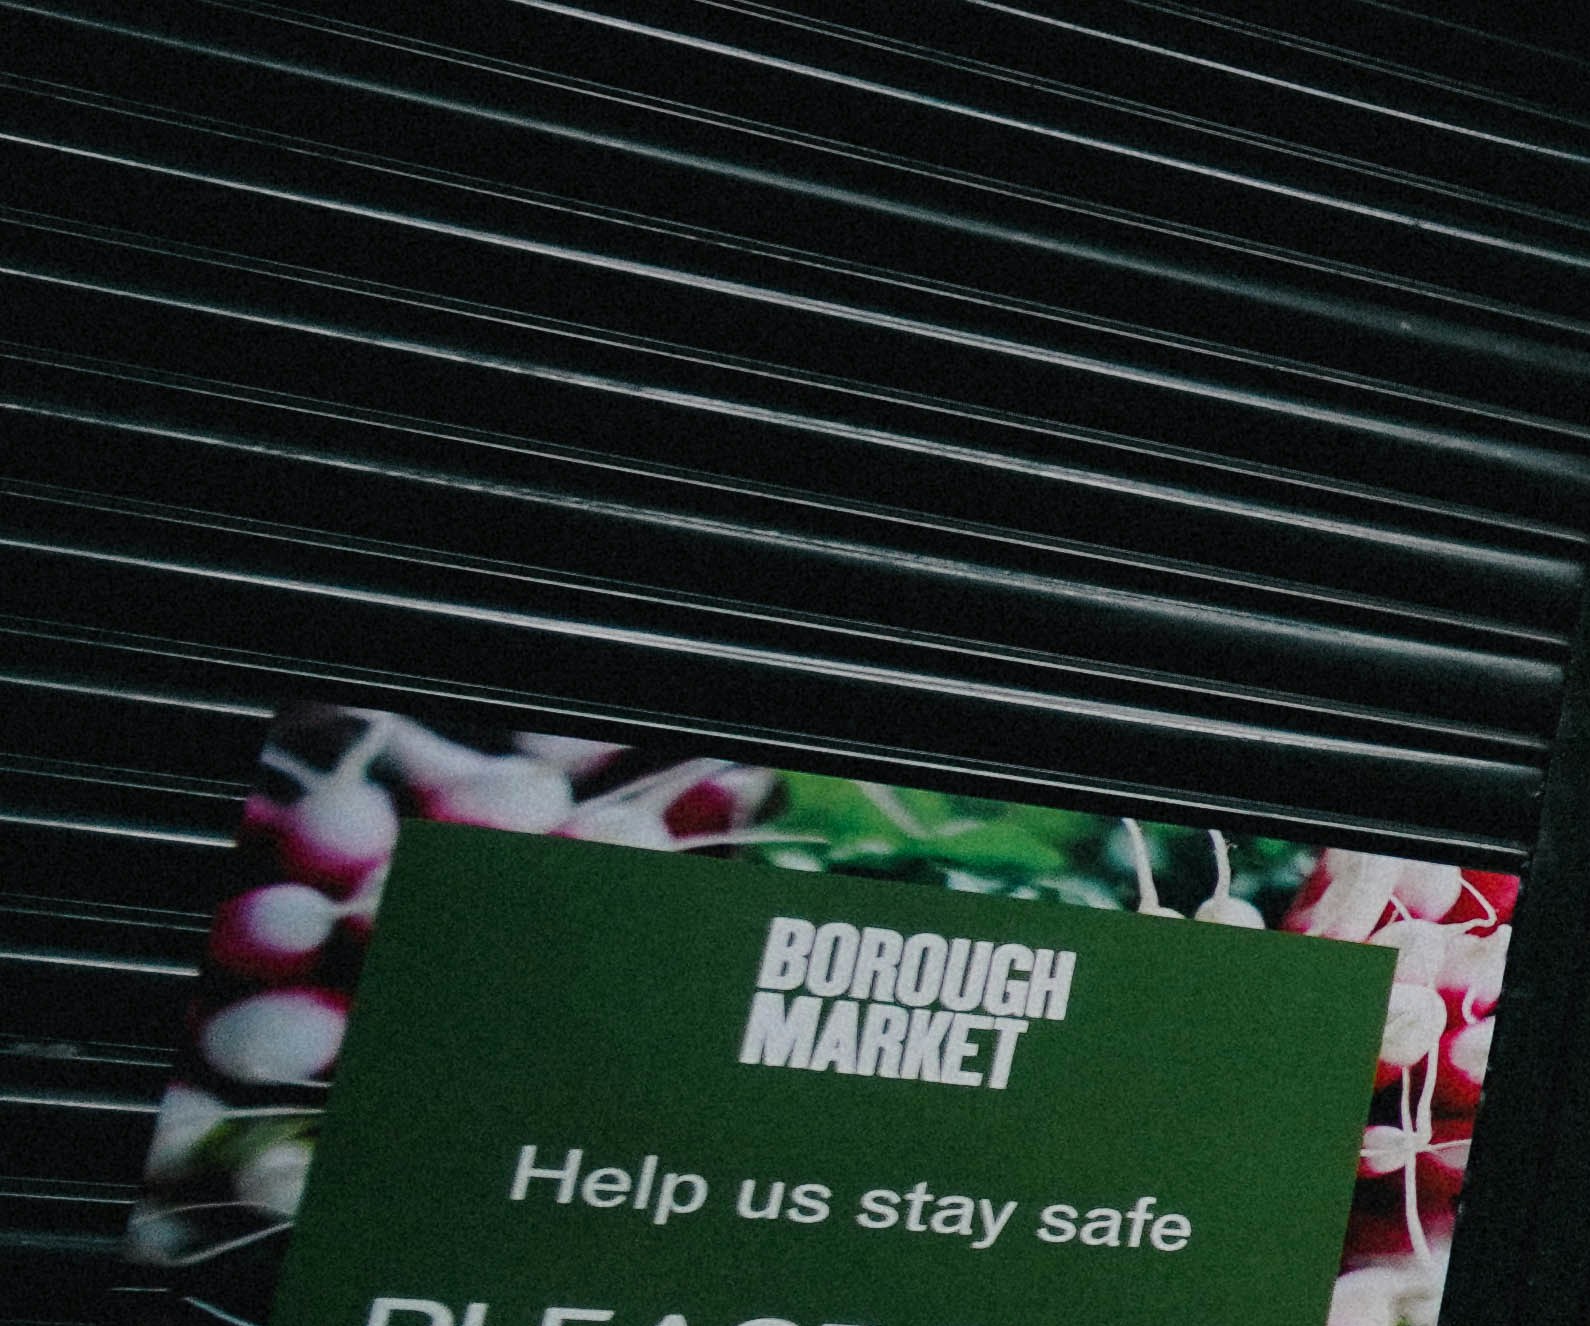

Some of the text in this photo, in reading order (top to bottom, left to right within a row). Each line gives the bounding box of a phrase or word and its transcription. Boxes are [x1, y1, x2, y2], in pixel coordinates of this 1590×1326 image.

[757, 917, 1076, 1020] BOROUGH
[739, 991, 1029, 1089] MARKET
[511, 1145, 1191, 1251] Help us stay safe
